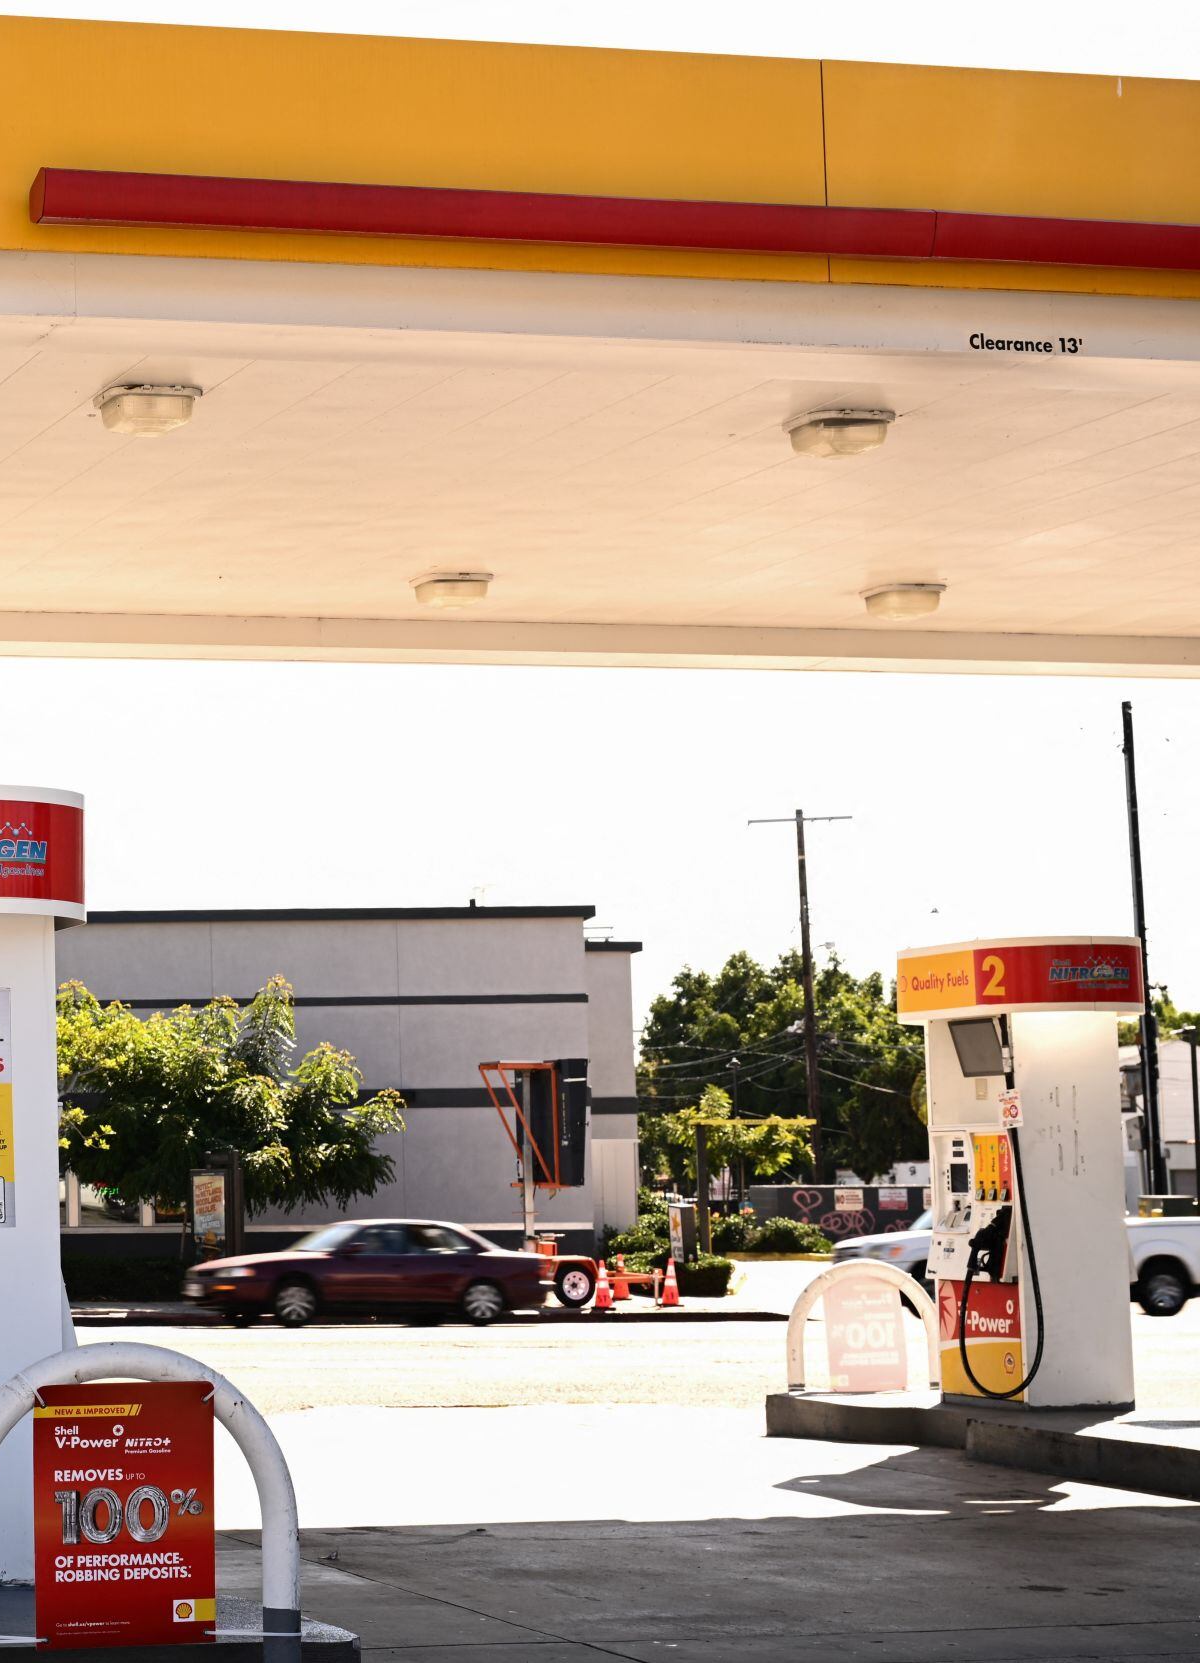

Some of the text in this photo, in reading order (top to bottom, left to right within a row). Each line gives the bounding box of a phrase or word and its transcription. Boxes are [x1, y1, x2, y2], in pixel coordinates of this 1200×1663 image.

[969, 332, 1083, 354] Clearance 13'
[911, 971, 969, 992] Quality Fuels
[981, 955, 1006, 997] 2
[83, 1407, 125, 1415] IMPROVED
[54, 1425, 79, 1435] Shell
[54, 1437, 119, 1449] V-Power
[54, 1469, 124, 1482] REMOVES
[54, 1485, 203, 1545] 100%
[54, 1552, 184, 1568] OF PERFORMANCE-
[55, 1569, 121, 1583] ROBBING
